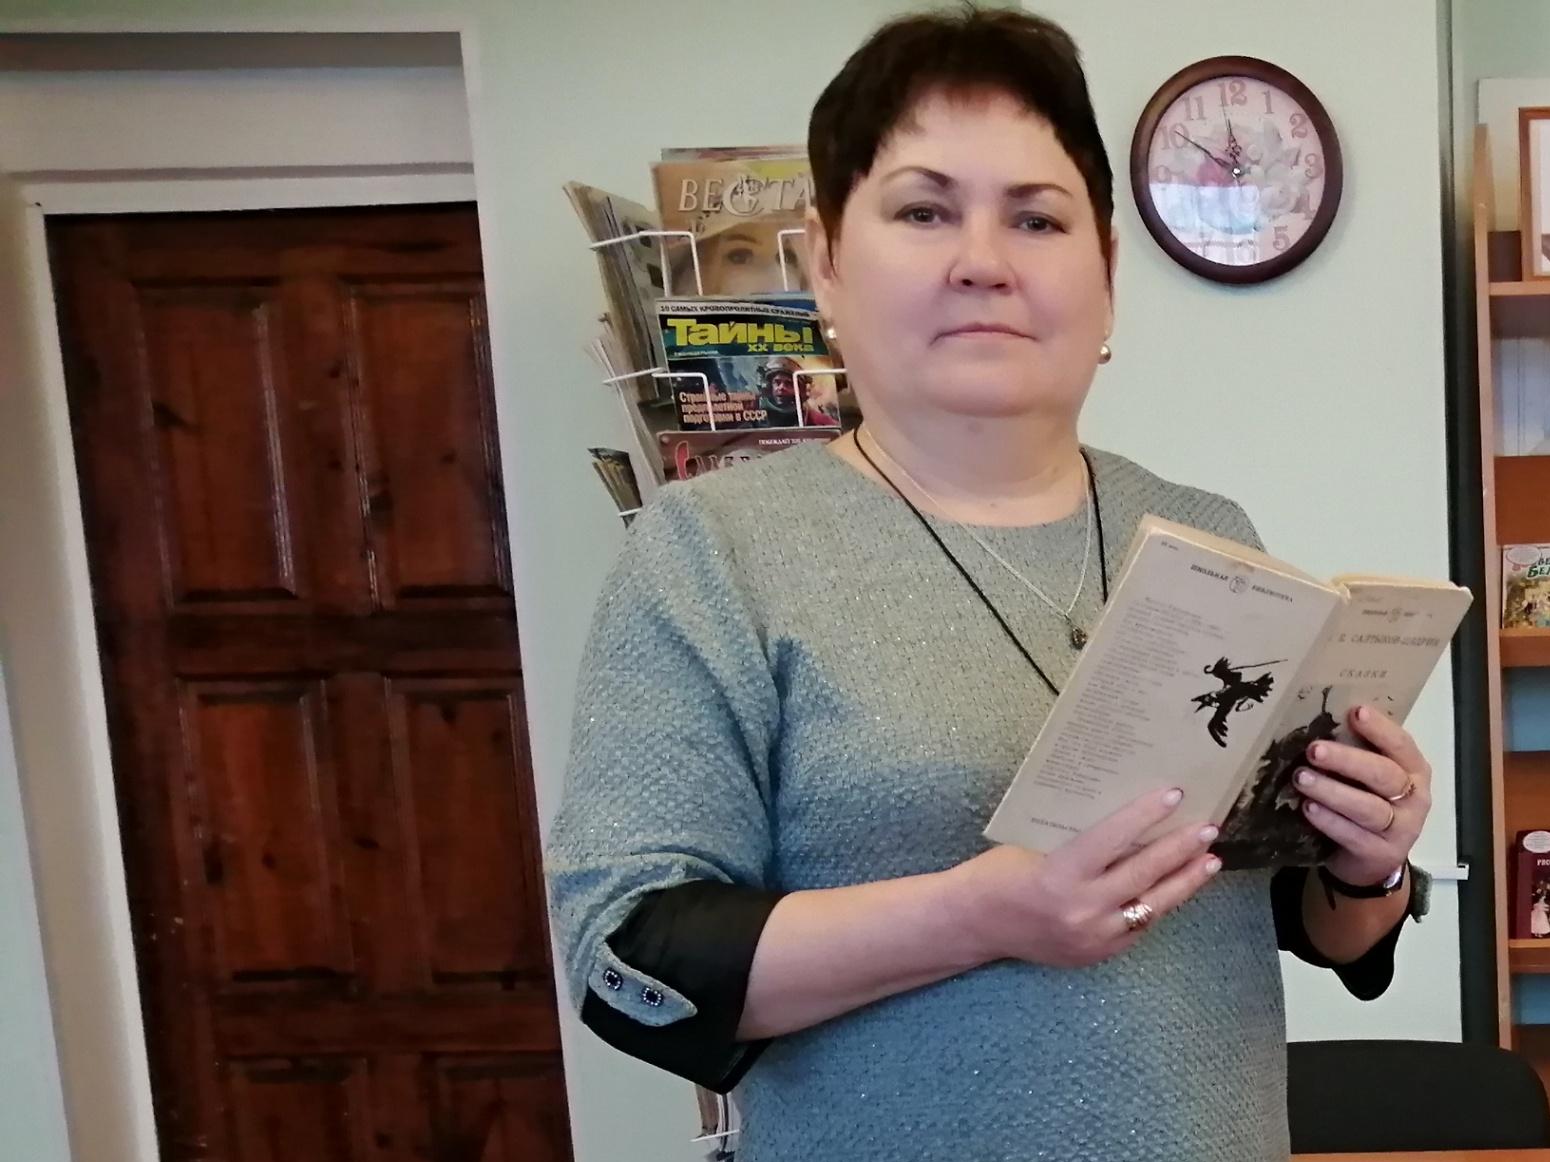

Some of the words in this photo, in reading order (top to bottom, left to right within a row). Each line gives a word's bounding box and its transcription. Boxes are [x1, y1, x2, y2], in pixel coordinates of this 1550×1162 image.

[1217, 79, 1247, 107] 12
[1262, 90, 1274, 114] 1
[1181, 96, 1207, 121] 11
[1160, 122, 1189, 150] 10
[1289, 113, 1308, 138] 2
[1304, 153, 1323, 180] 3
[1291, 192, 1316, 221] 4
[1272, 225, 1290, 251] 5
[667, 318, 814, 346] Тайны
[743, 410, 768, 422] СССР
